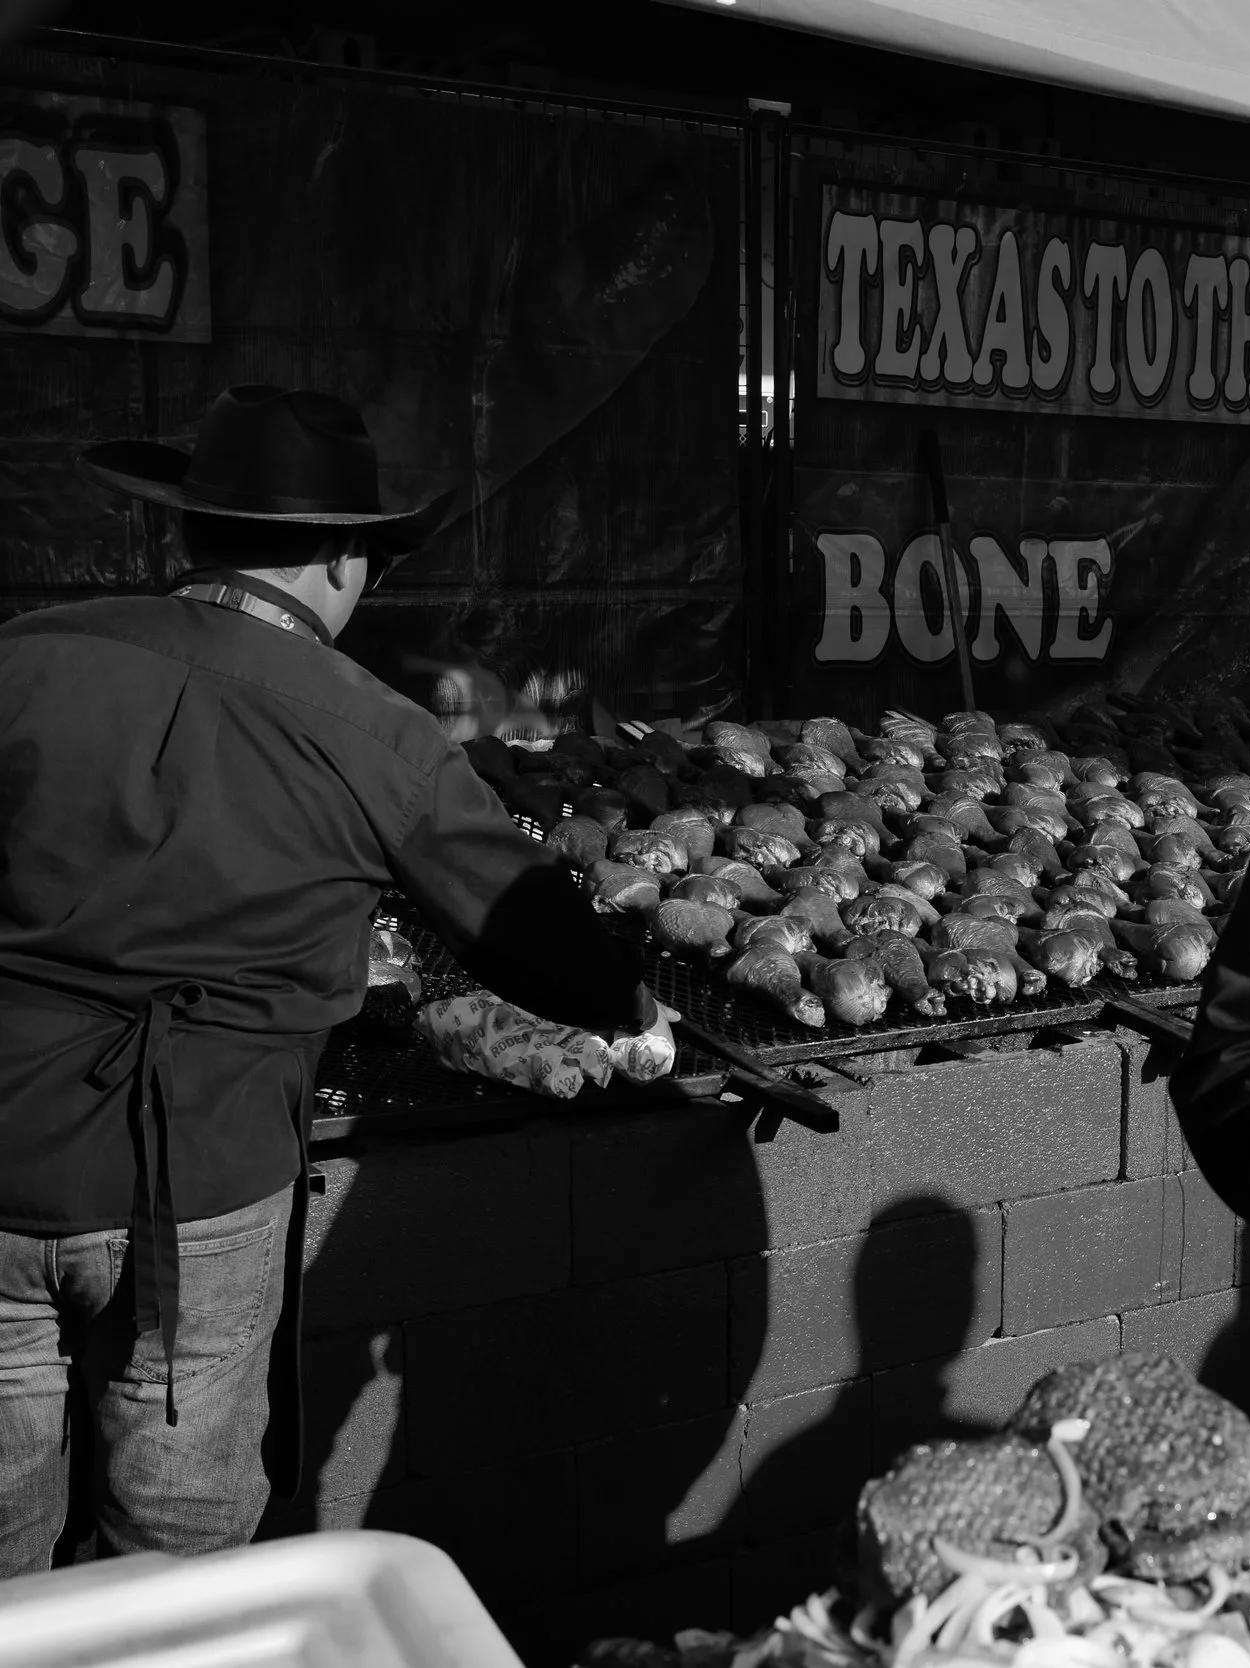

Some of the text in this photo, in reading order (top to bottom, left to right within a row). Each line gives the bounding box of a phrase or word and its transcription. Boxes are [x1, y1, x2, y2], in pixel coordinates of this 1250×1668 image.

[825, 209, 1074, 396] TEXAS
[1083, 240, 1178, 401] TO
[812, 532, 1115, 664] BONE
[491, 1032, 531, 1059] RODEO
